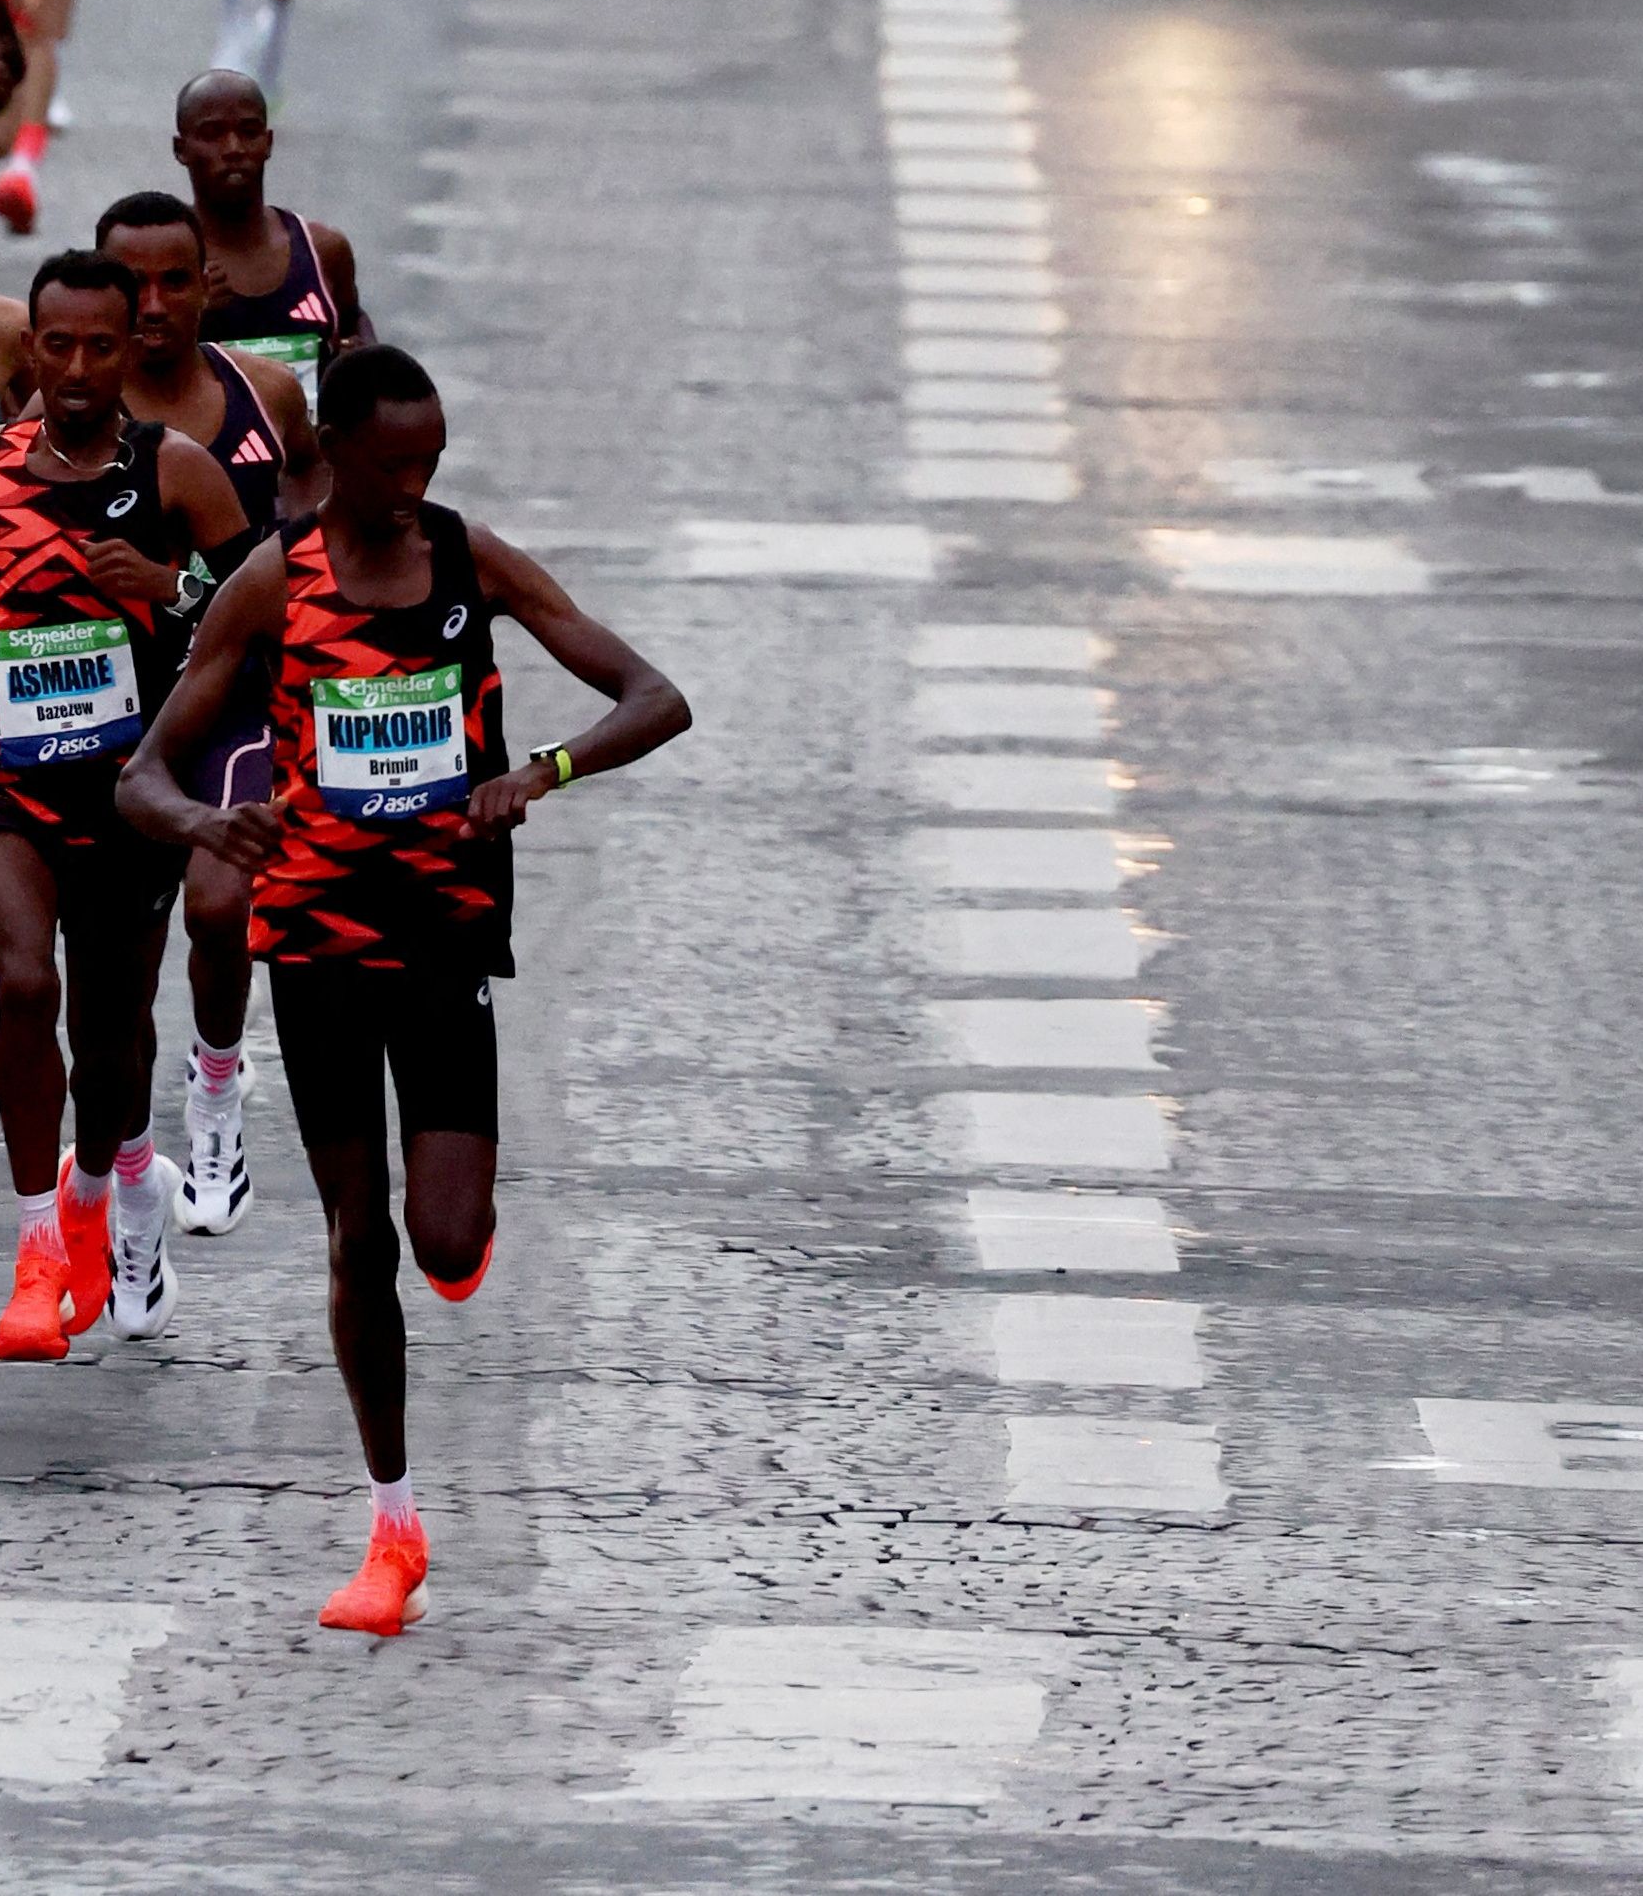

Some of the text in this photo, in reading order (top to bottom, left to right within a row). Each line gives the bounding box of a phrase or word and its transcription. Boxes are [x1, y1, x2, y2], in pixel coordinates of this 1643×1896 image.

[9, 624, 96, 647] Schneider
[9, 654, 112, 699] ASMARE
[338, 676, 436, 697] Schneider
[125, 697, 134, 713] 8
[328, 705, 452, 749] KIPKORIR
[58, 734, 101, 755] asics
[369, 757, 419, 776] Brimin
[384, 792, 429, 813] asics
